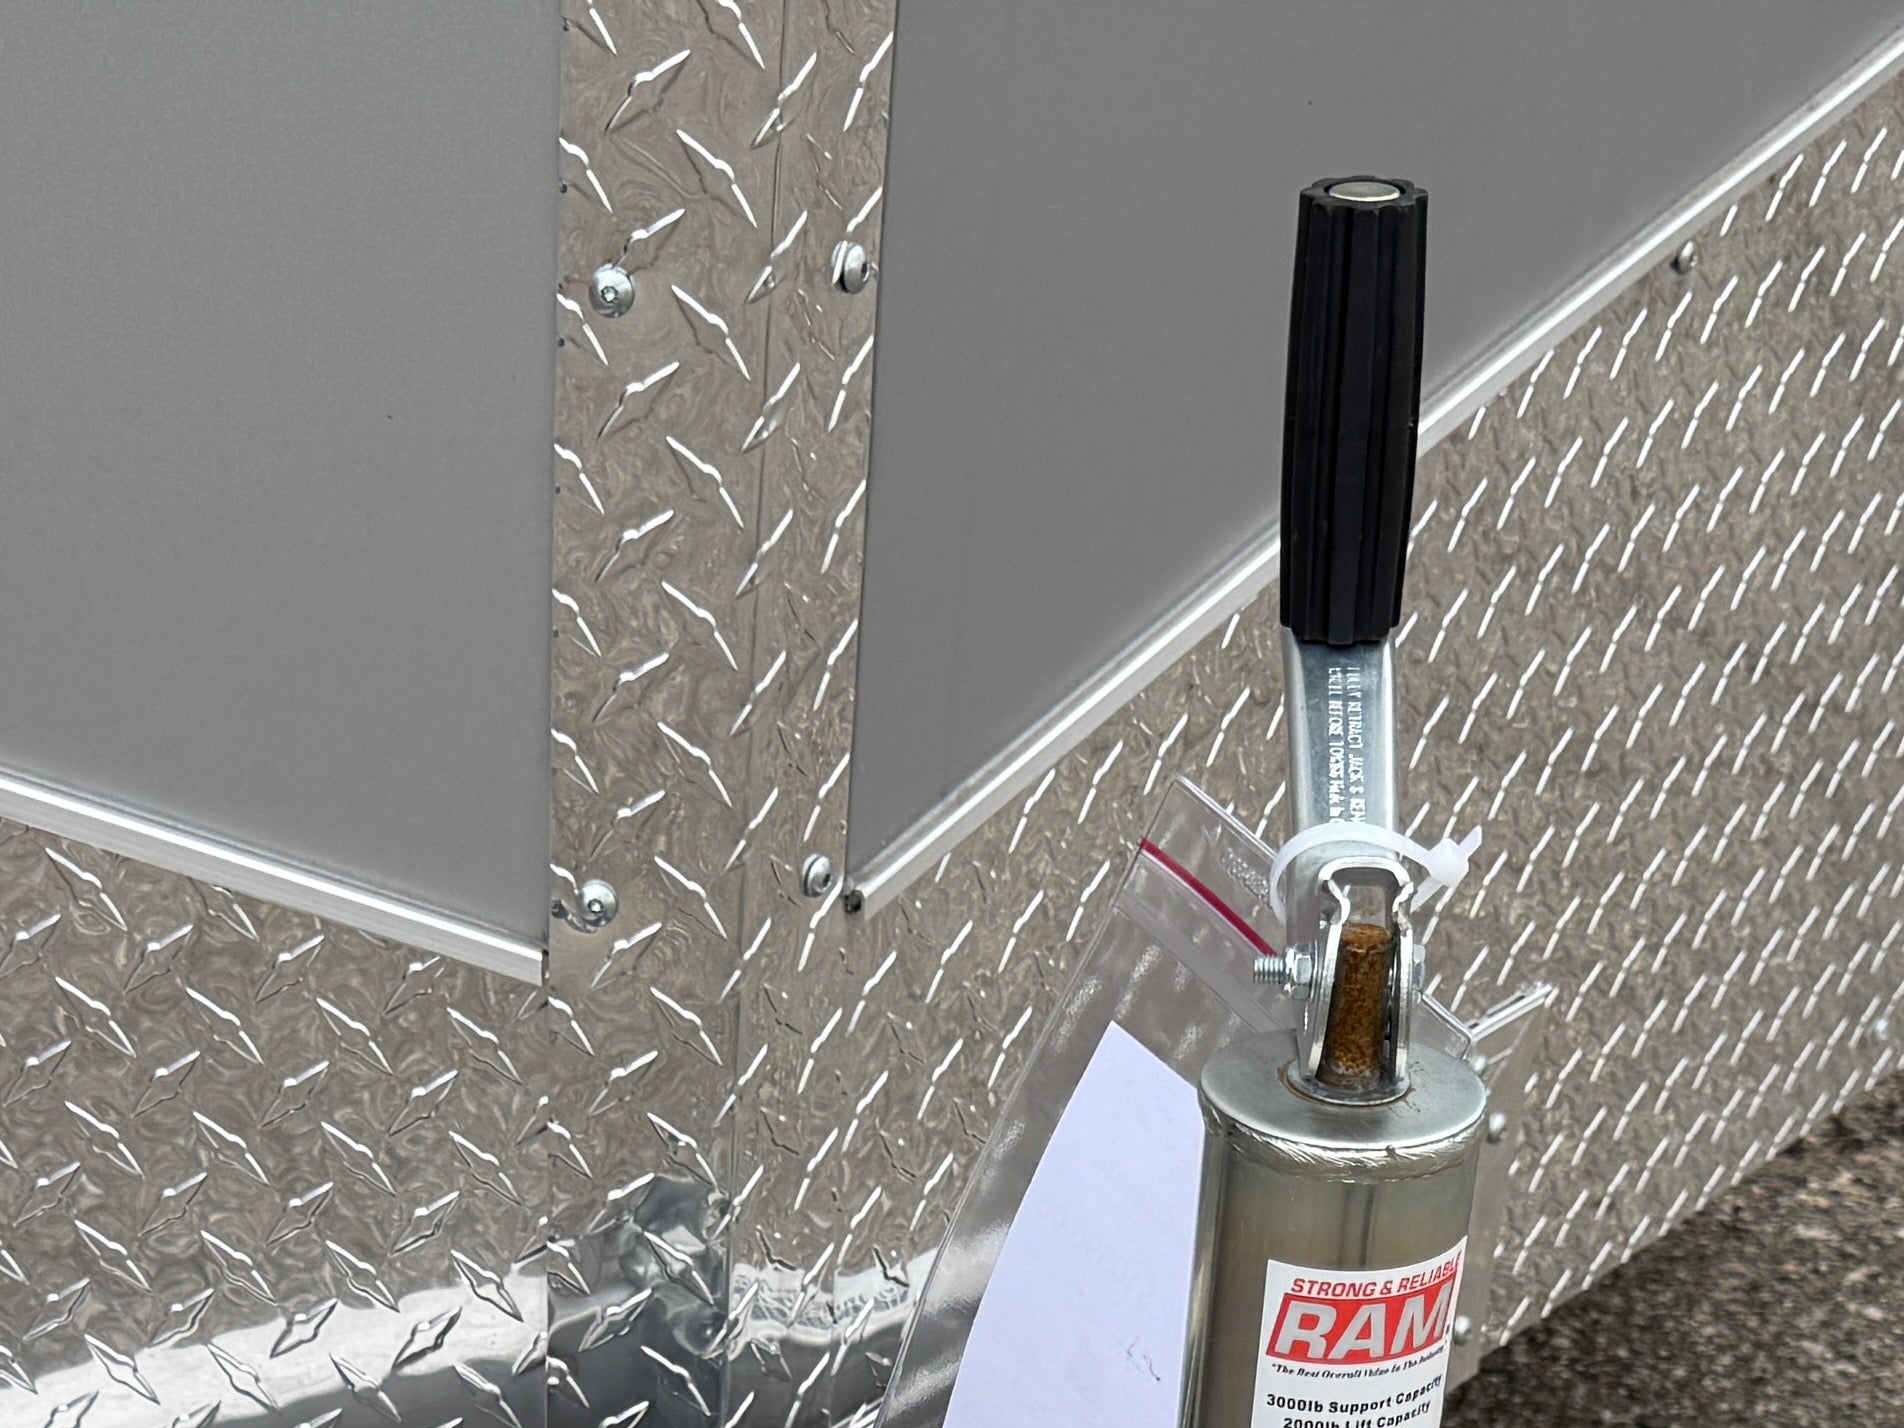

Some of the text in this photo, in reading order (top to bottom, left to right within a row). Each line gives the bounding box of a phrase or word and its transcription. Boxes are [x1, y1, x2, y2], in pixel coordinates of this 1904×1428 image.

[1291, 1250, 1462, 1298] STRONG & RELIABLE
[1274, 1282, 1454, 1360] RAM
[1267, 1374, 1443, 1416] 3000lb Support Capacity
[1377, 1400, 1432, 1428] Capacity
